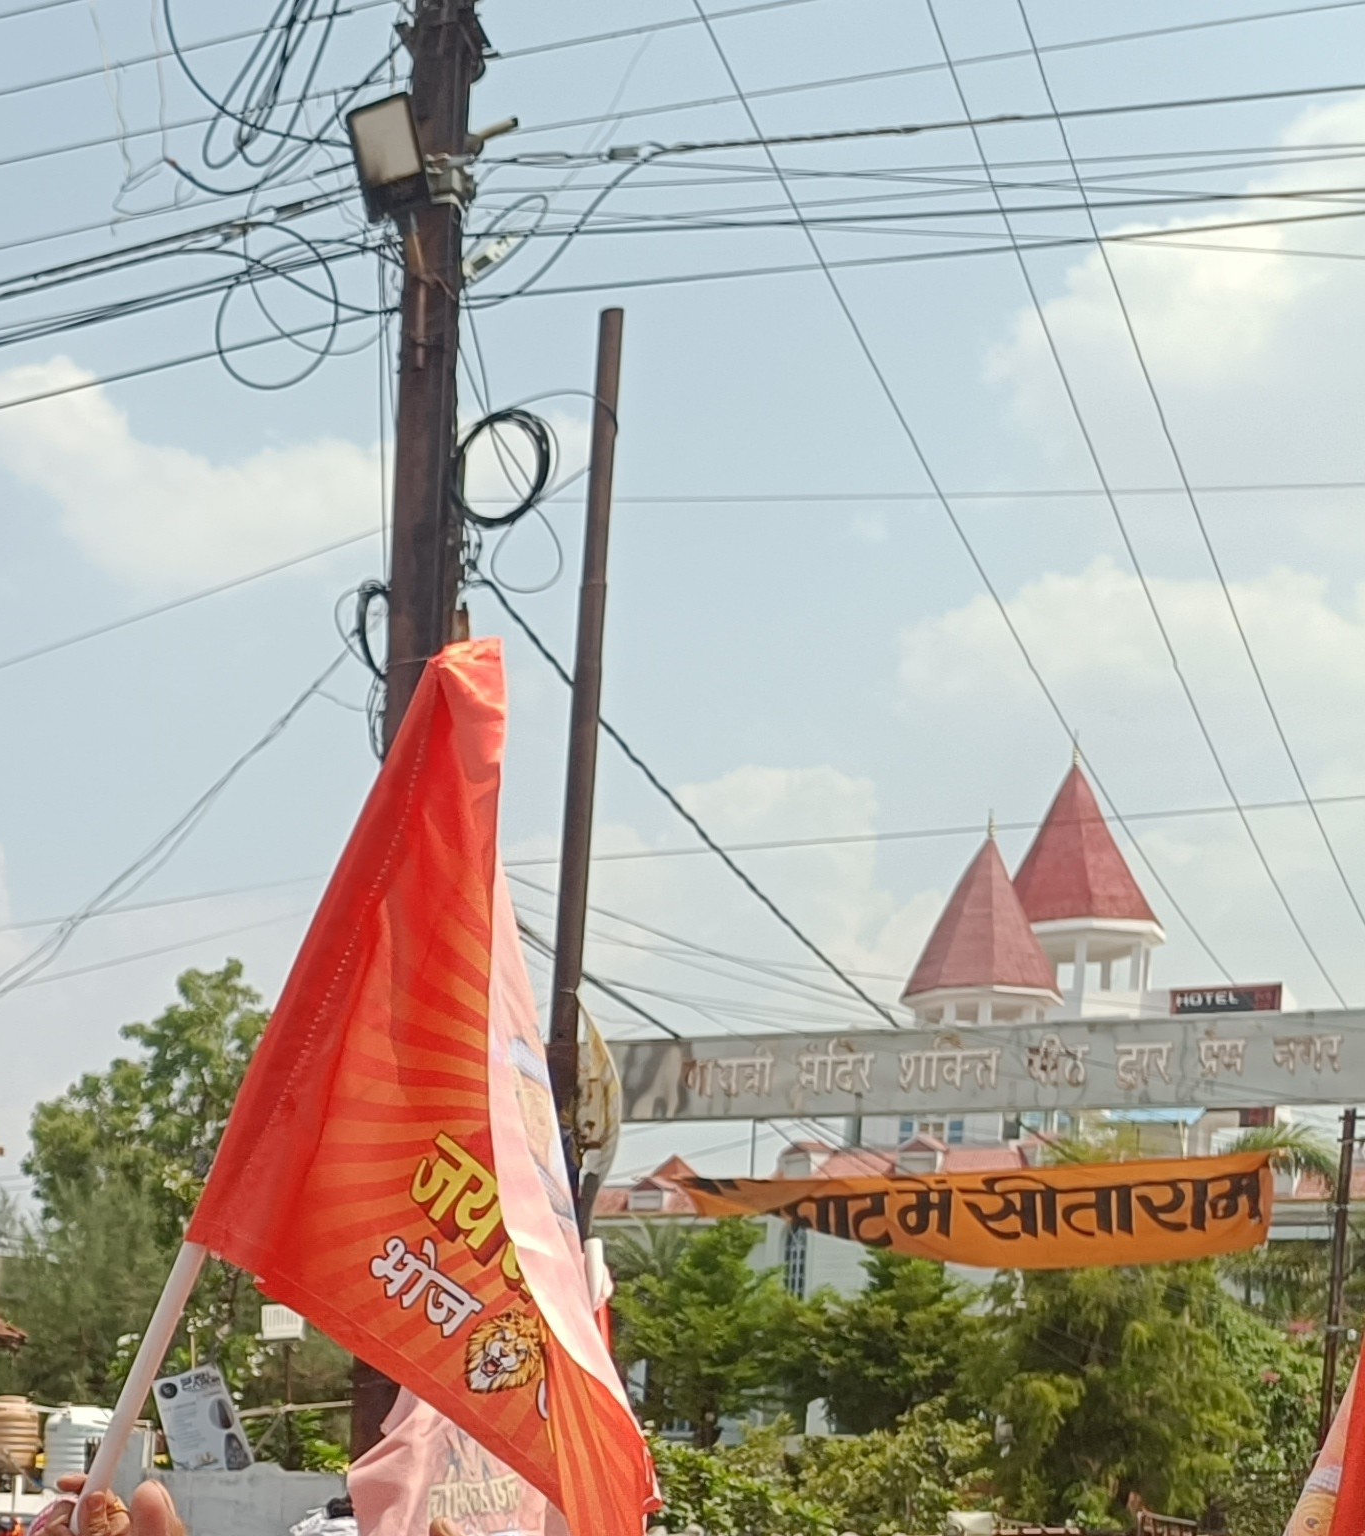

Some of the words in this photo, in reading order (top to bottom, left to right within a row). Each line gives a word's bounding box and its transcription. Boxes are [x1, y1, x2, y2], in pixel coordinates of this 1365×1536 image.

[1175, 990, 1240, 1008] HOTEL
[798, 1037, 875, 1095] मंदिर
[1114, 1041, 1173, 1090] द्वार
[1272, 1033, 1343, 1074] नगर
[410, 1132, 504, 1252] जय
[369, 1235, 485, 1339] भोज
